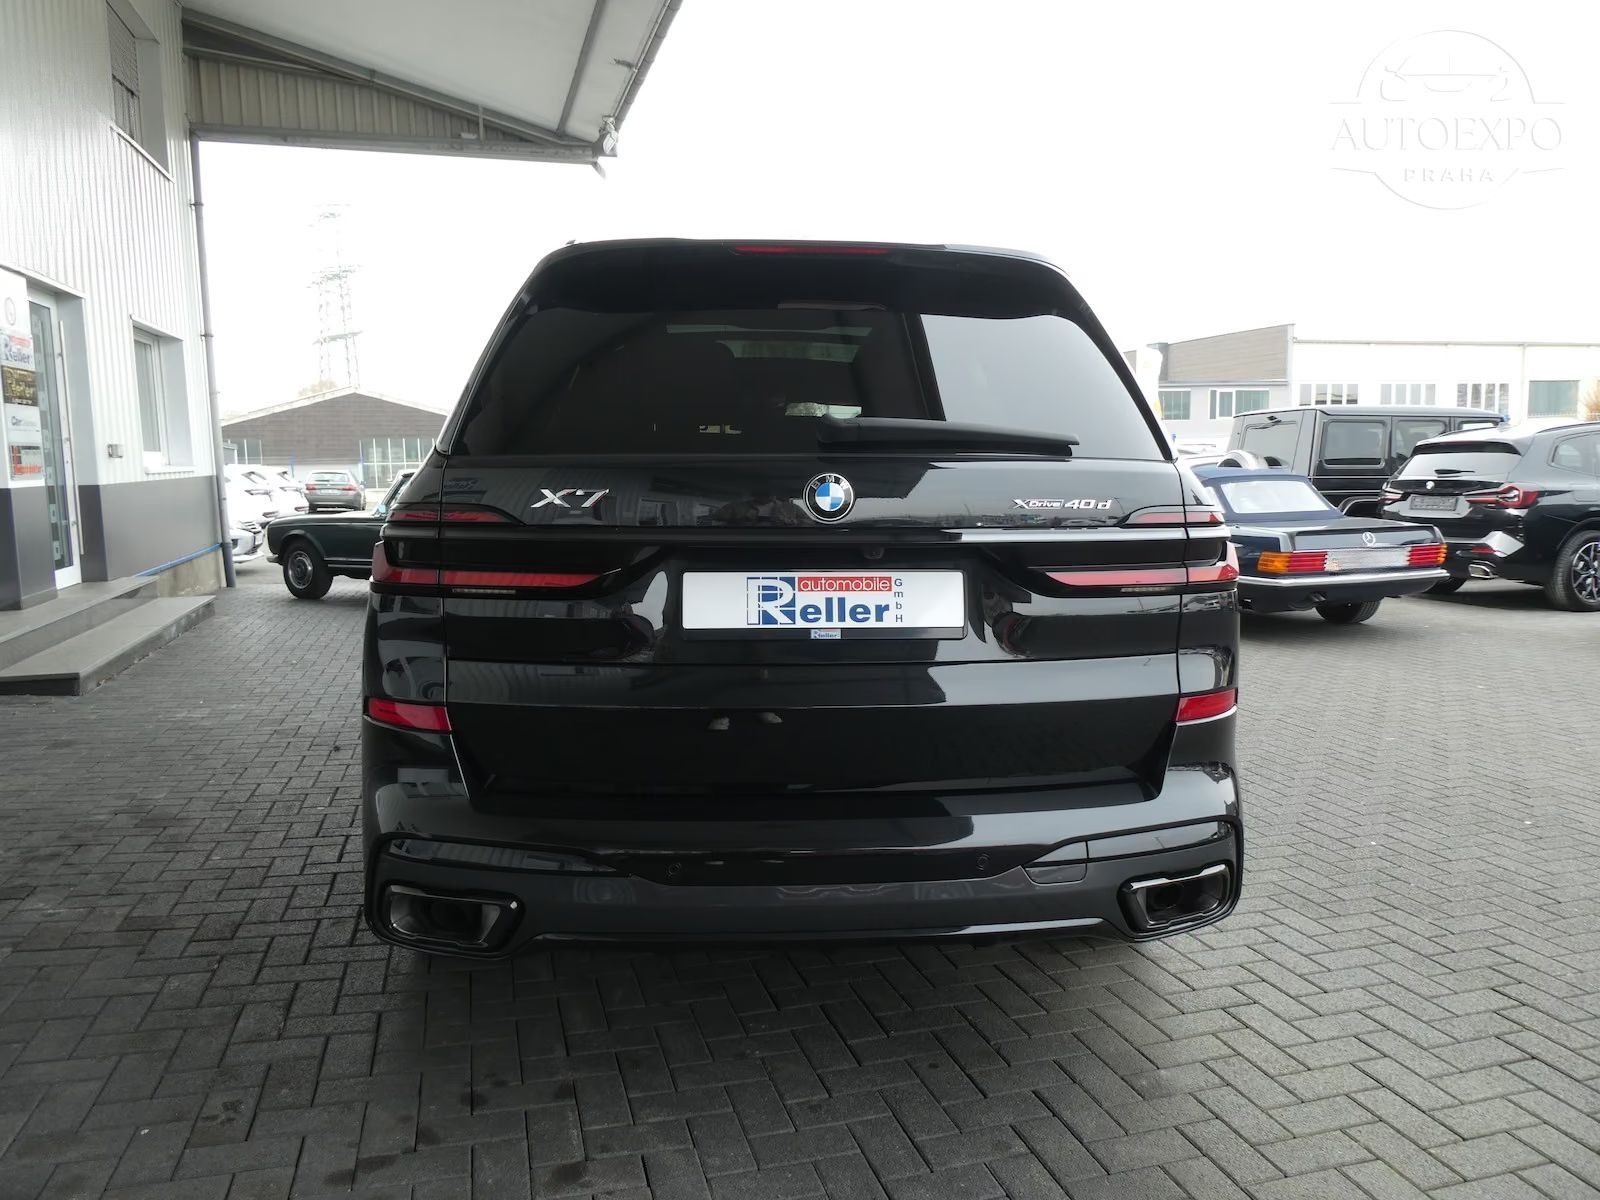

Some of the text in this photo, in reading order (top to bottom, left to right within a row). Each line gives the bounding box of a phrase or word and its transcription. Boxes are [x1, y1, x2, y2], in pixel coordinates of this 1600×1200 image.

[810, 474, 851, 490] BMW
[530, 488, 610, 508] X7
[799, 577, 891, 592] automobile
[746, 576, 890, 626] Reller
